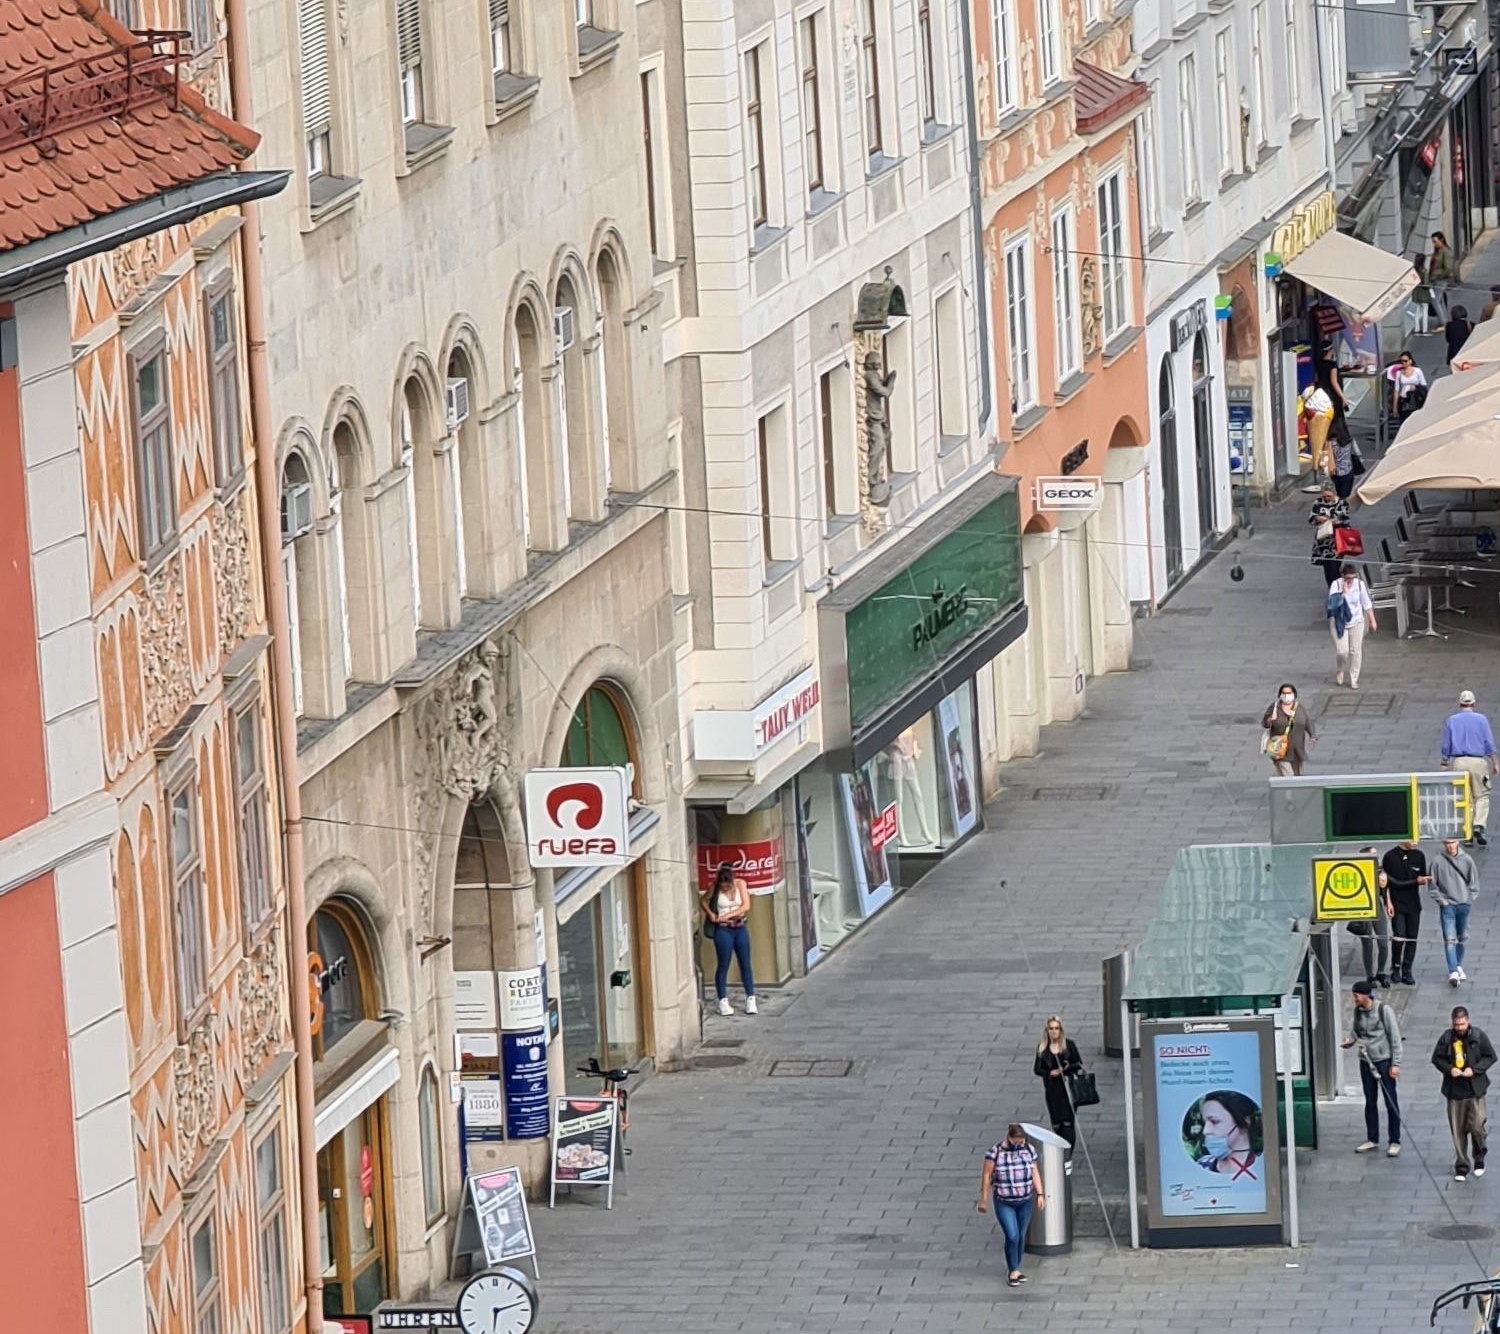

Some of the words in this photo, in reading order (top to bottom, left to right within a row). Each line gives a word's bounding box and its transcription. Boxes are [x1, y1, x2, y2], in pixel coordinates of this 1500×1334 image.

[1045, 488, 1093, 499] GEOX
[912, 583, 968, 652] PALMERS
[538, 838, 616, 856] ruefa
[1333, 872, 1357, 889] HH
[1160, 1047, 1174, 1055] SO
[469, 1098, 499, 1110] 1880
[382, 1313, 454, 1327] UHREN
